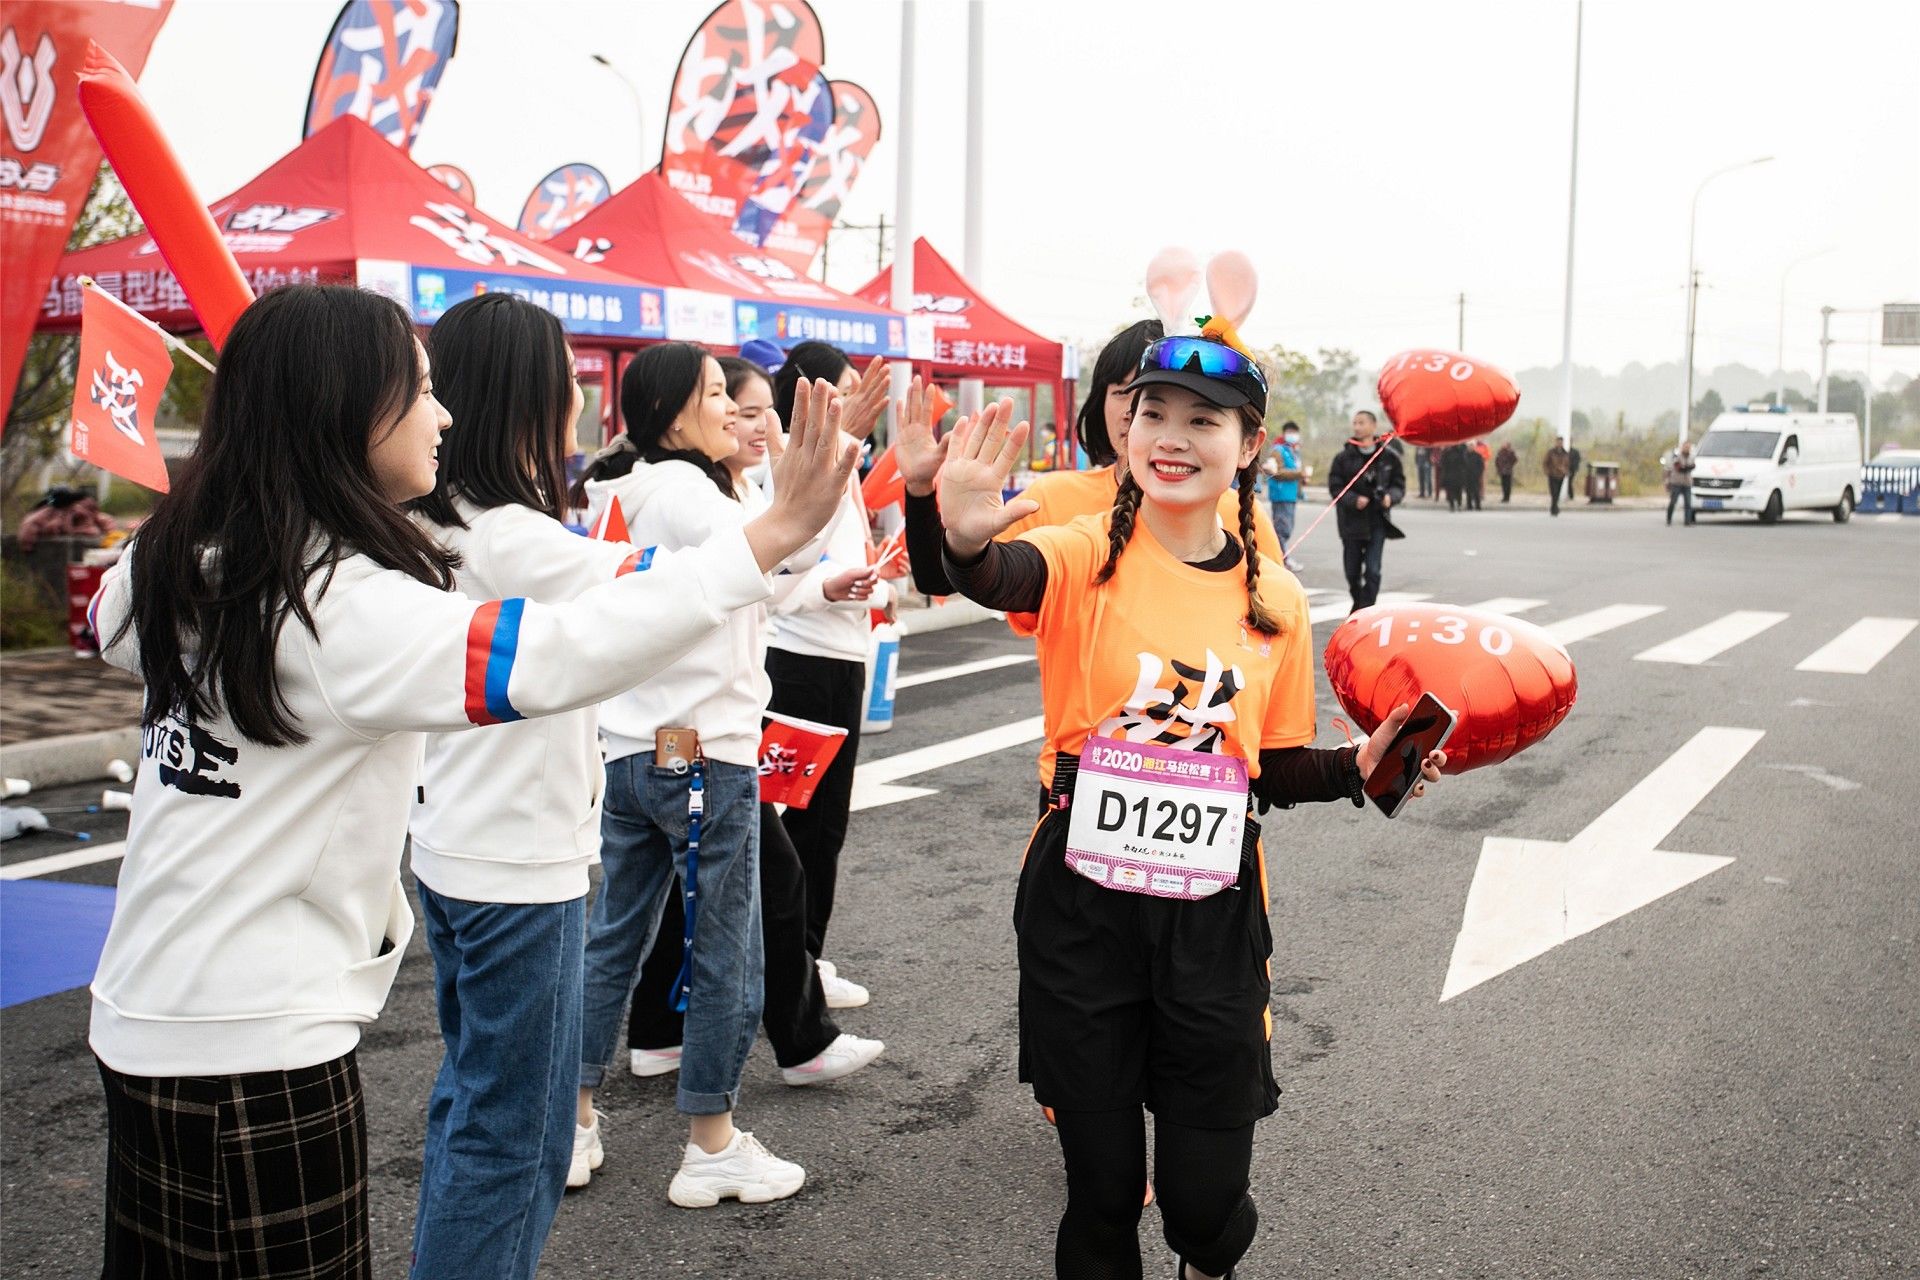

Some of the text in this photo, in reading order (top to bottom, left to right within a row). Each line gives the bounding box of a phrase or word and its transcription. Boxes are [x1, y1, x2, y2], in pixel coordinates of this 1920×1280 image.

[1396, 352, 1475, 382] 1:30
[1371, 615, 1513, 656] 1:30
[1096, 789, 1228, 847] D1297
